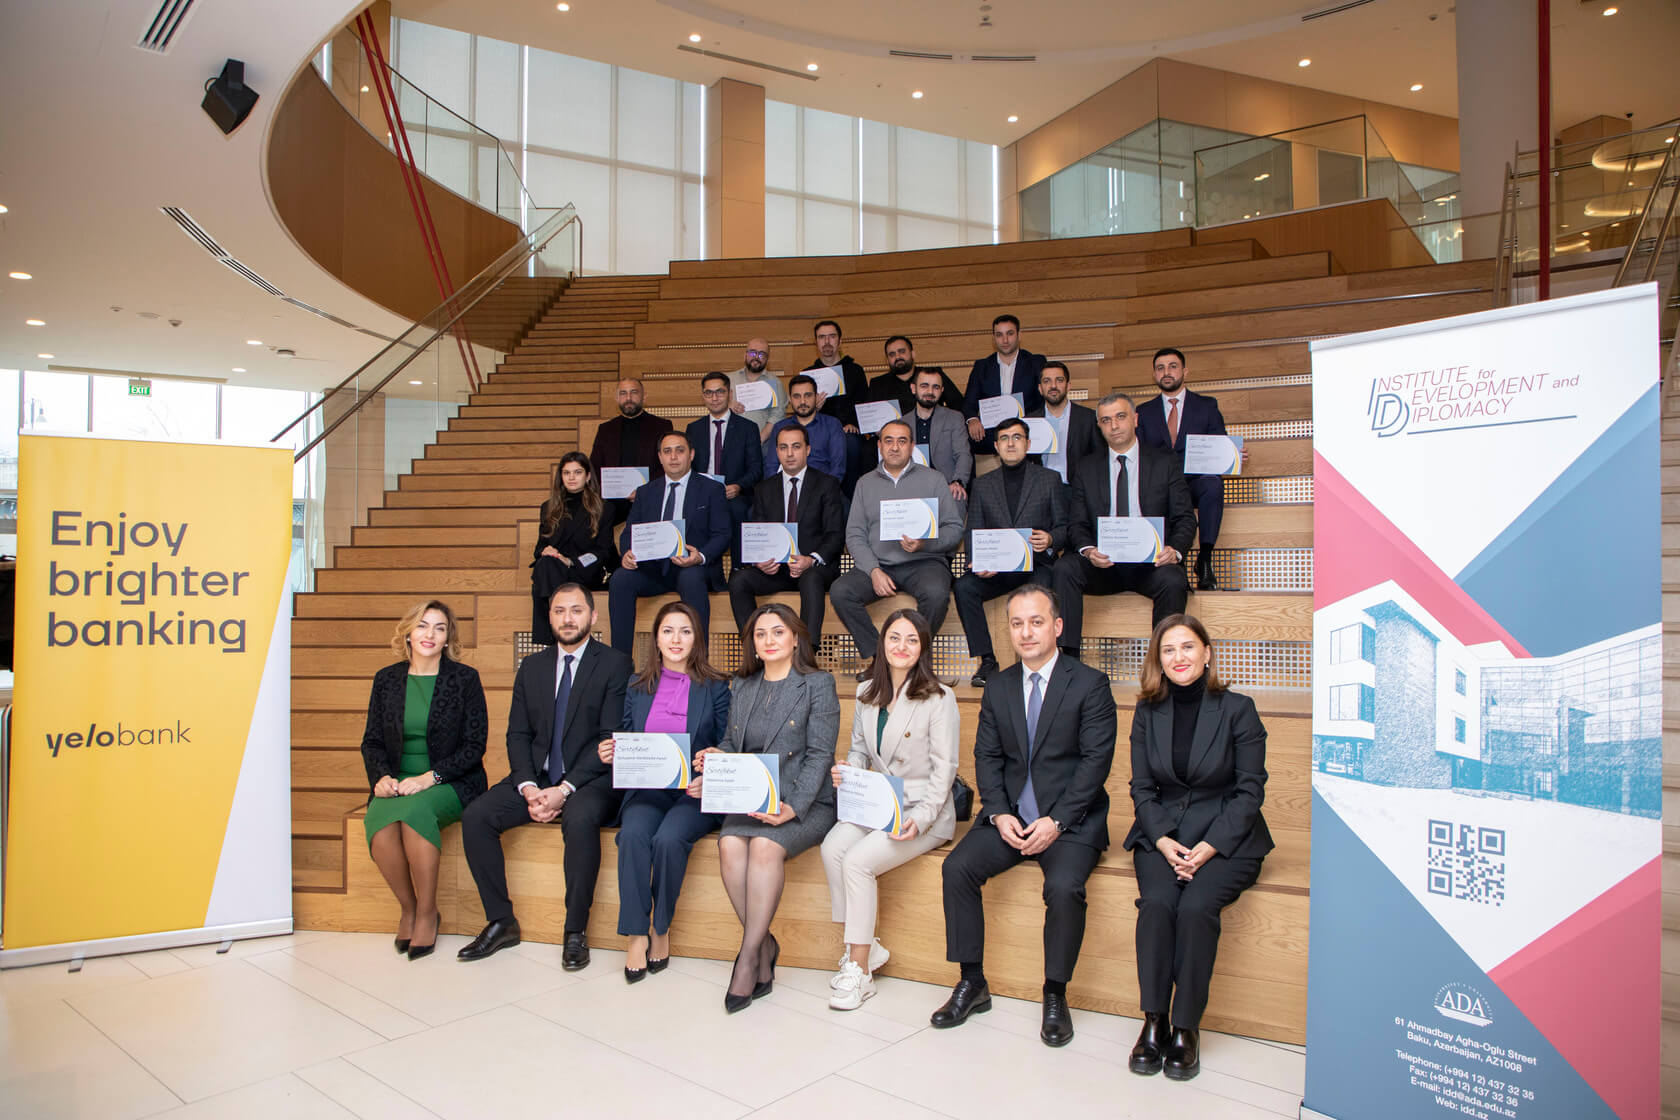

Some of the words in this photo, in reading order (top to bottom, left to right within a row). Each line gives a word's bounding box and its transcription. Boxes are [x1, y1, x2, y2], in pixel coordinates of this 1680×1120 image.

[131, 385, 150, 395] EXIT
[1478, 368, 1497, 380] for
[1552, 374, 1580, 389] and
[51, 510, 189, 557] Enjoy
[48, 560, 250, 606] brighter
[47, 610, 247, 653] banking
[1440, 990, 1487, 1018] ADA
[1395, 1016, 1405, 1027] 61
[1407, 1020, 1454, 1042] Ahmadbay
[1455, 1034, 1506, 1057] Agha-Oglu
[1507, 1049, 1537, 1066] Street
[1407, 1031, 1432, 1047] Baku,
[1433, 1039, 1484, 1063] Azerbaijan,
[1485, 1055, 1523, 1073] AZ1008
[1396, 1049, 1443, 1071] Telephone:
[1487, 1078, 1505, 1091] 437
[1507, 1084, 1520, 1096] 32
[1409, 1064, 1428, 1078] Fax:
[1472, 1085, 1490, 1098] 437
[1492, 1091, 1504, 1103] 32
[1410, 1076, 1441, 1093] E-mail:
[1442, 1086, 1517, 1119] idd@ada.edu.az
[1435, 1095, 1459, 1111] Web:
[1460, 1103, 1489, 1120] idd.az
